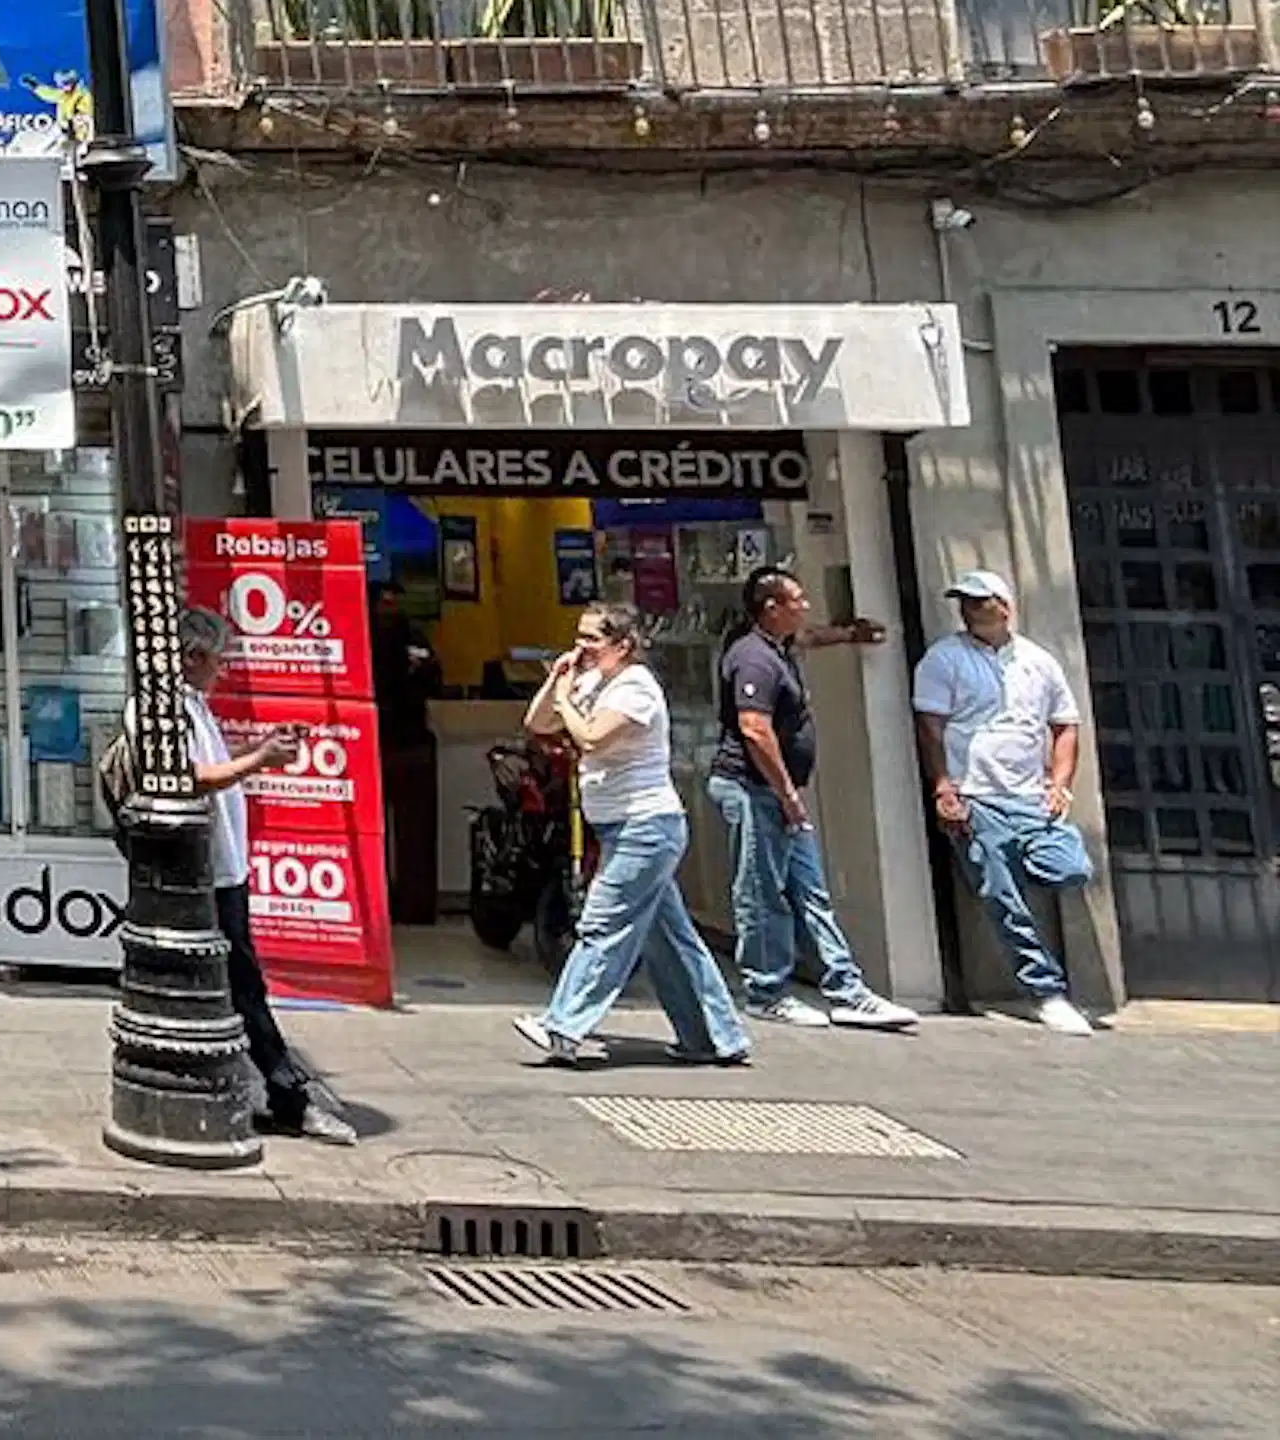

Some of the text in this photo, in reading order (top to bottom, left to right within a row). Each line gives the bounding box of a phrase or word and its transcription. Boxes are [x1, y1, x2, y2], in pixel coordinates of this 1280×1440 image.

[1212, 301, 1261, 334] 12
[397, 316, 844, 406] Macropay
[561, 449, 600, 487] A
[609, 440, 807, 488] CRÉDITO
[216, 532, 328, 561] Rebajas
[228, 571, 332, 637] 0%
